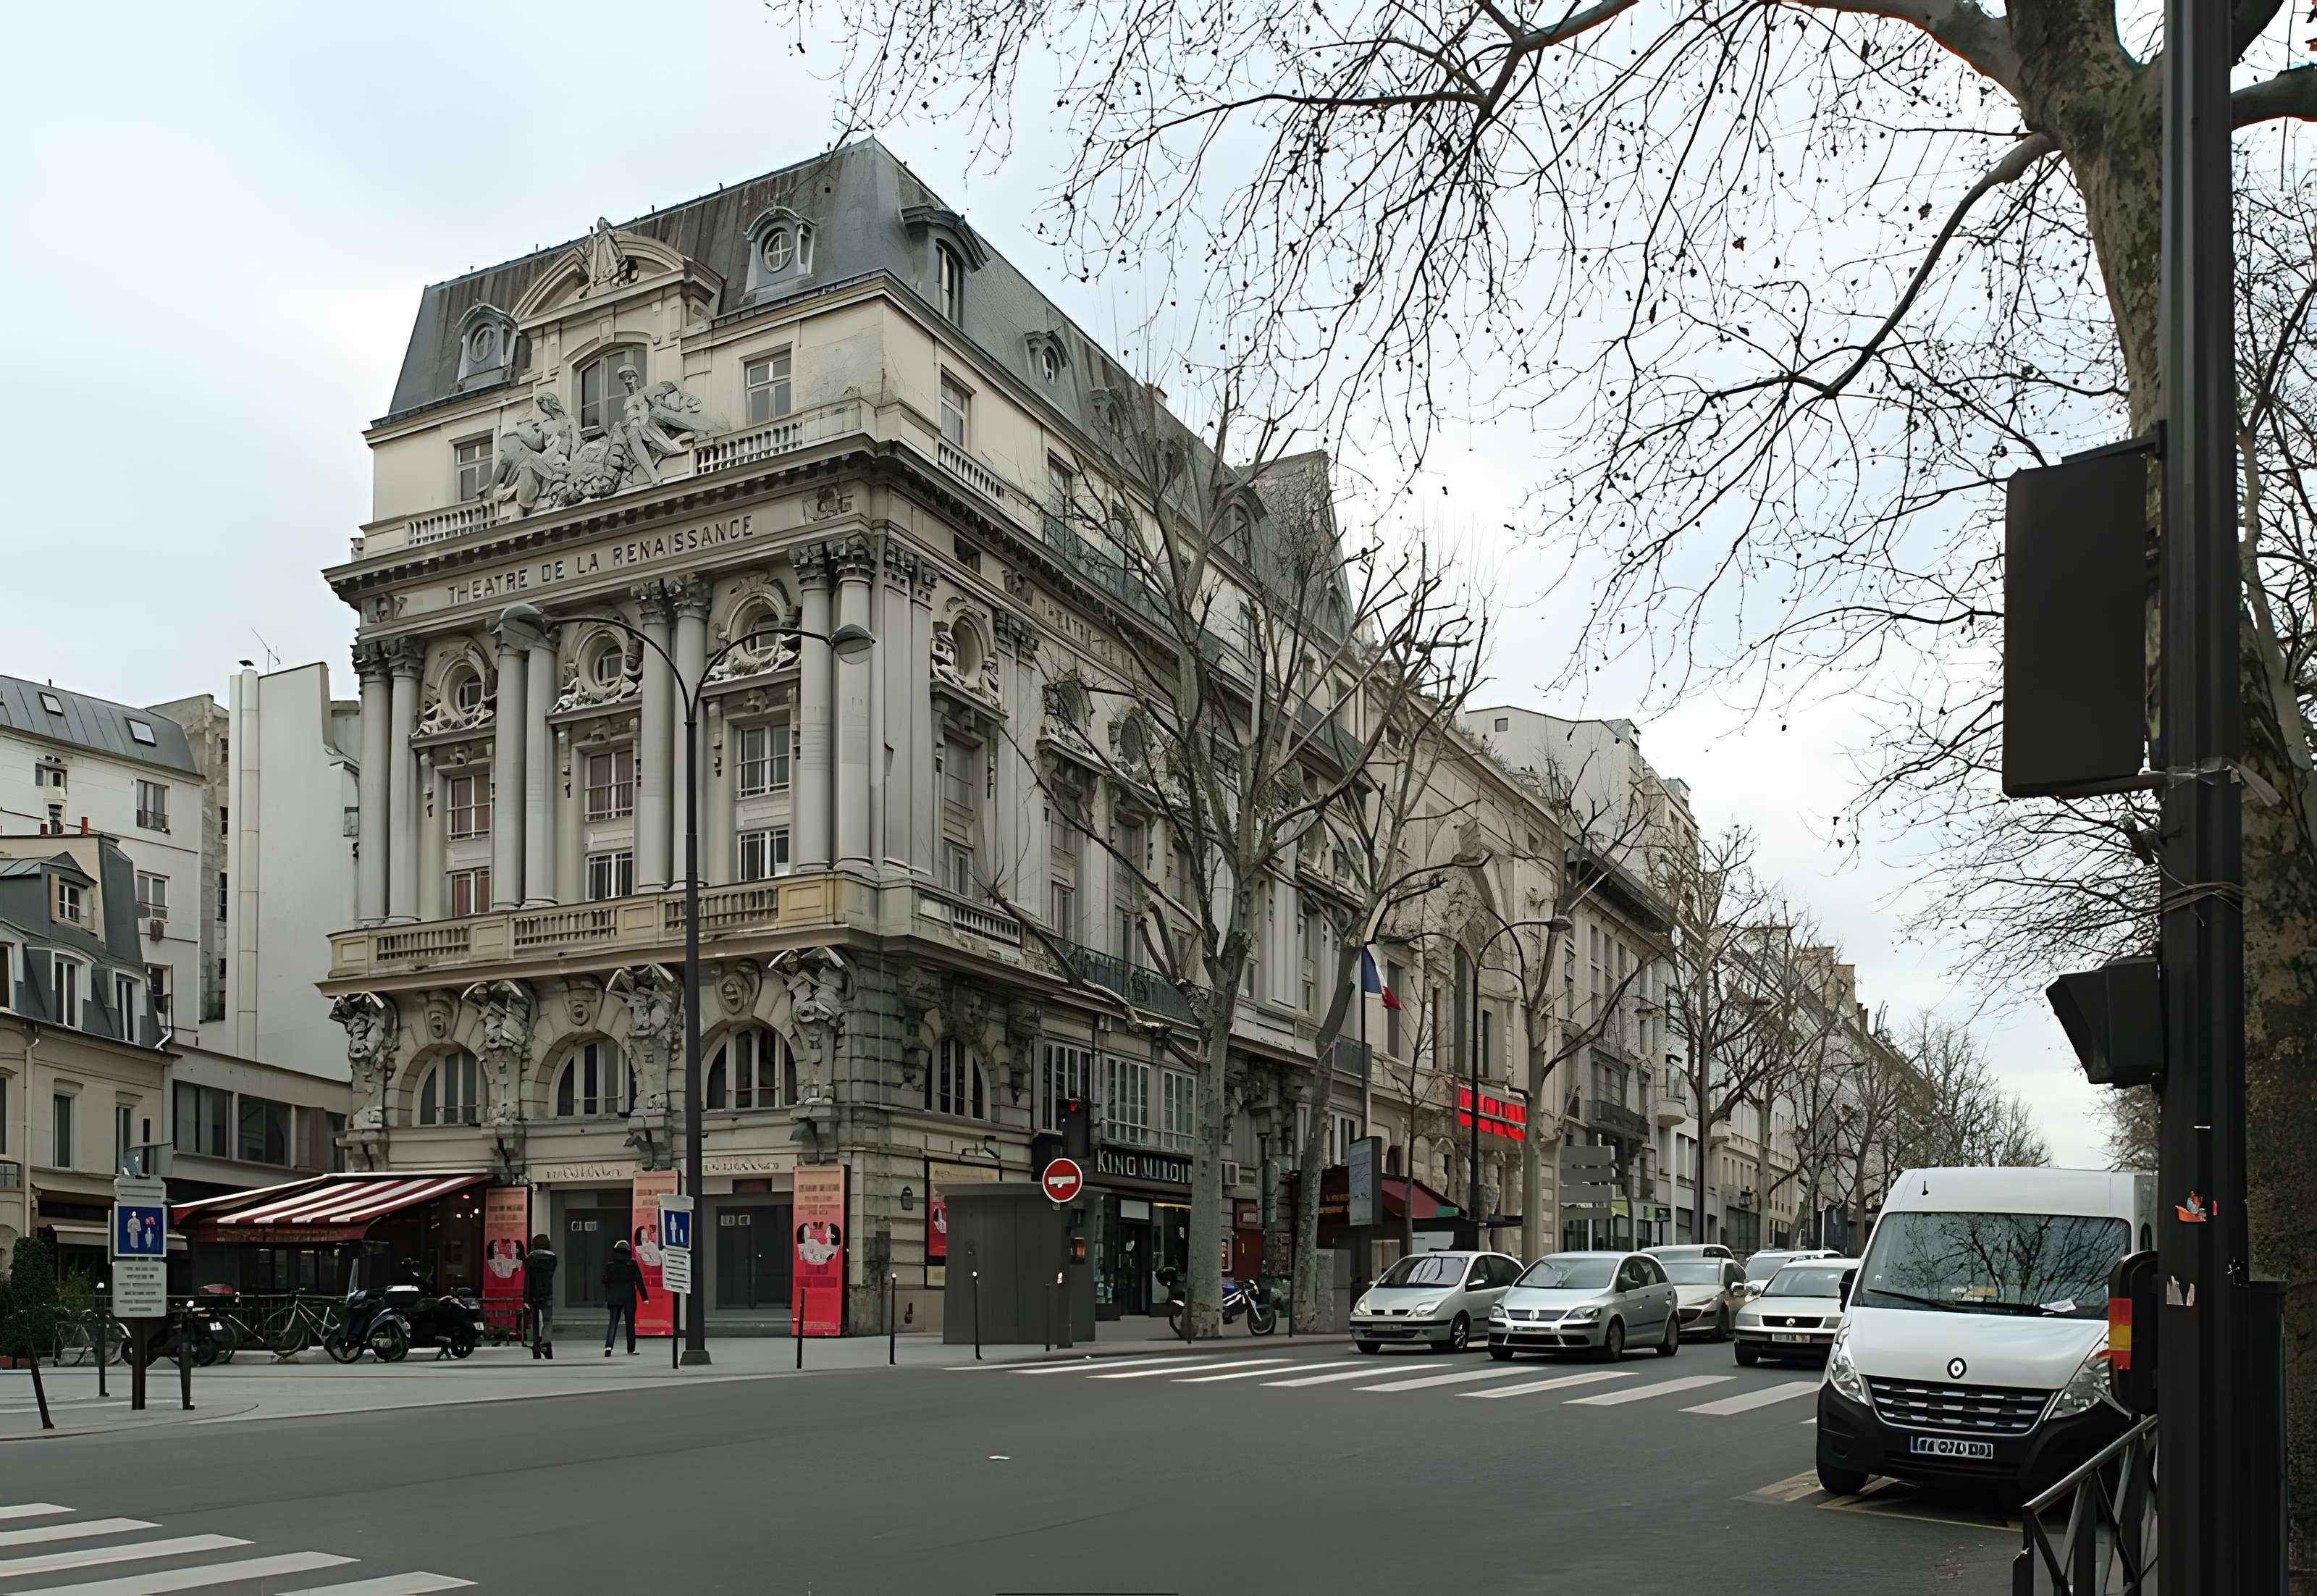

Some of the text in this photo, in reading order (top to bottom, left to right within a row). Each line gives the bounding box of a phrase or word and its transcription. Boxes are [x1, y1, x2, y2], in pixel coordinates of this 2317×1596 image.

[447, 515, 754, 604] THEATRE DE LA RENAISSANCE
